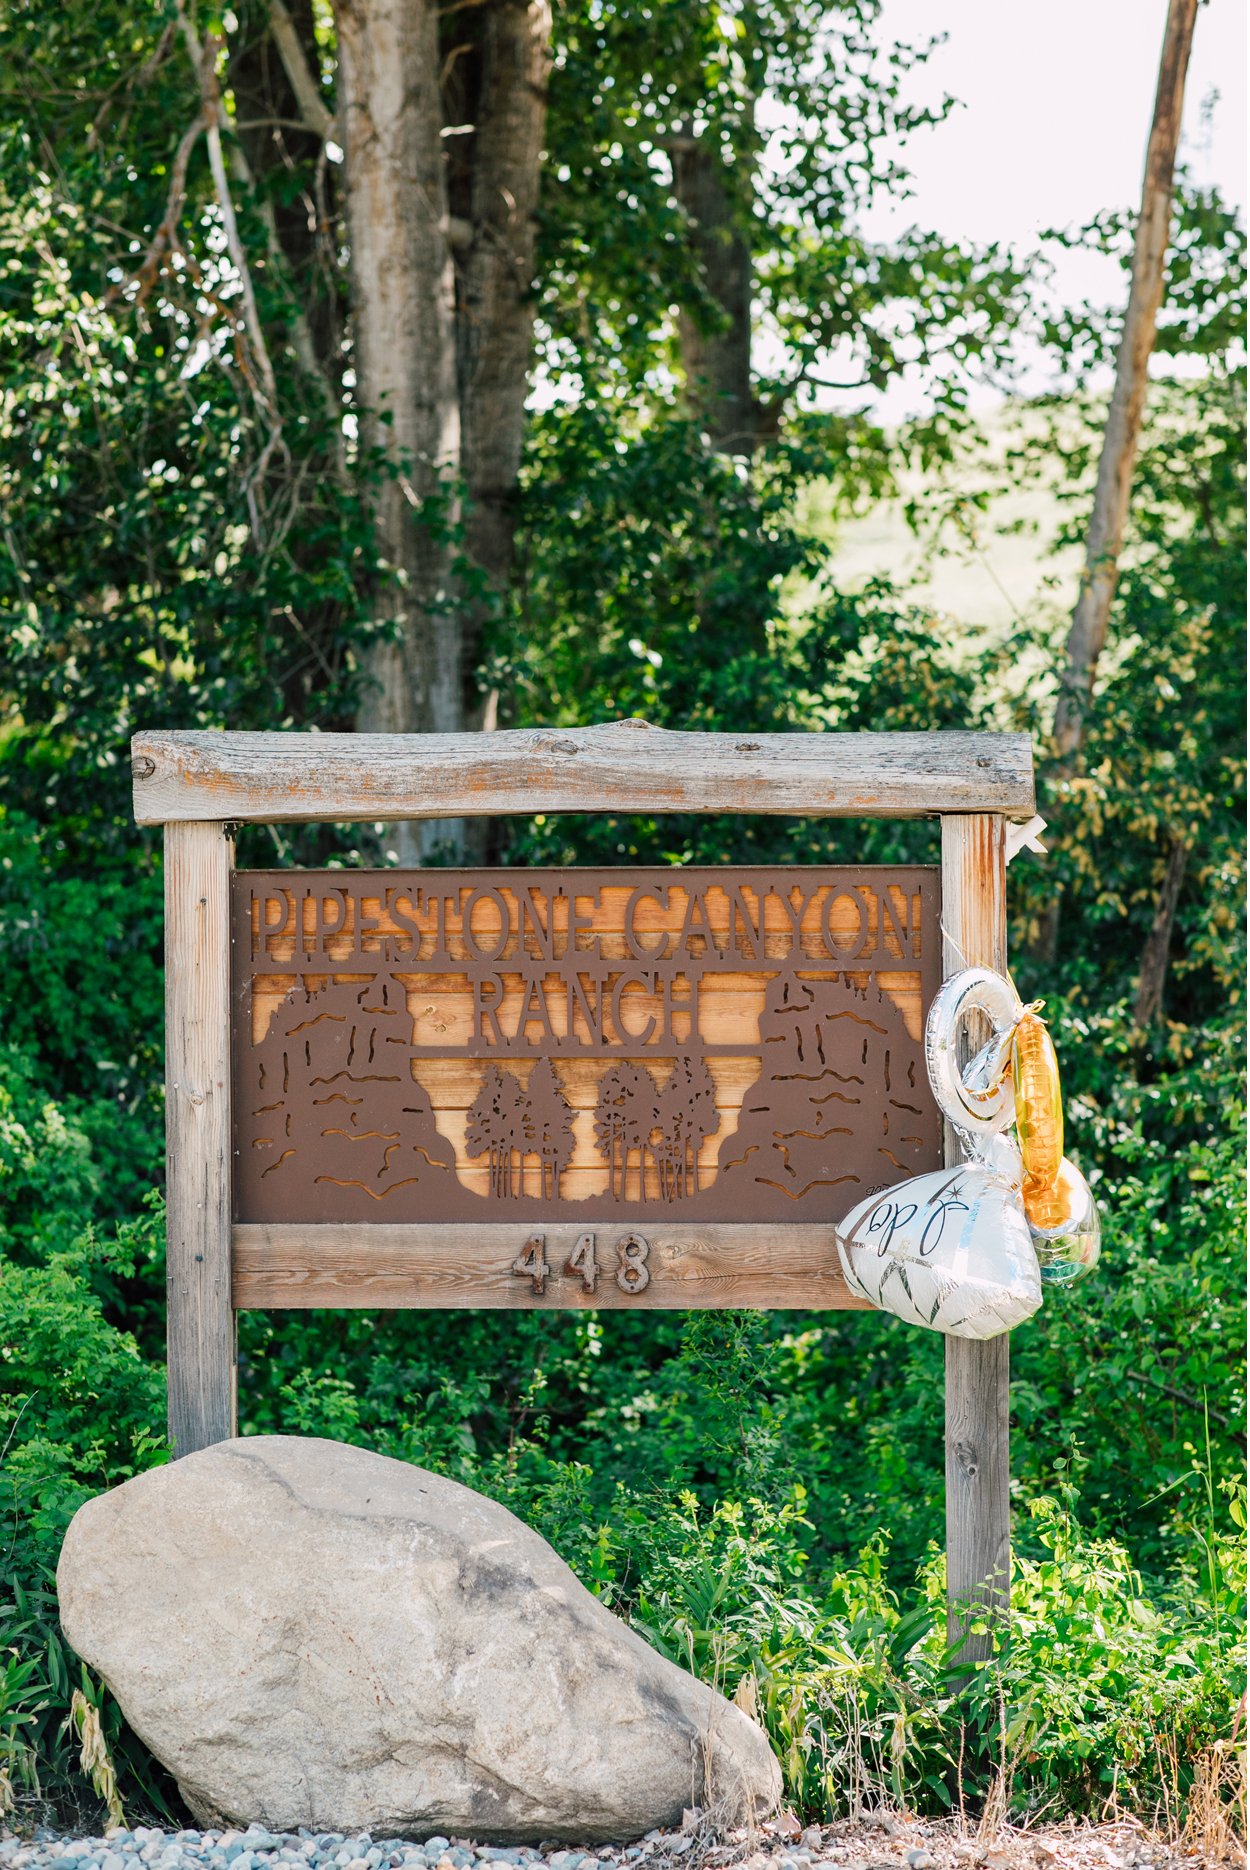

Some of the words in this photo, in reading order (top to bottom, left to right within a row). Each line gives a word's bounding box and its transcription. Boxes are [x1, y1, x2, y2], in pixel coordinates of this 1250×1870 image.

[251, 886, 600, 961] PIPESTONE
[625, 885, 921, 960] CANYON
[467, 971, 705, 1046] RANCH
[512, 1232, 650, 1294] 448
